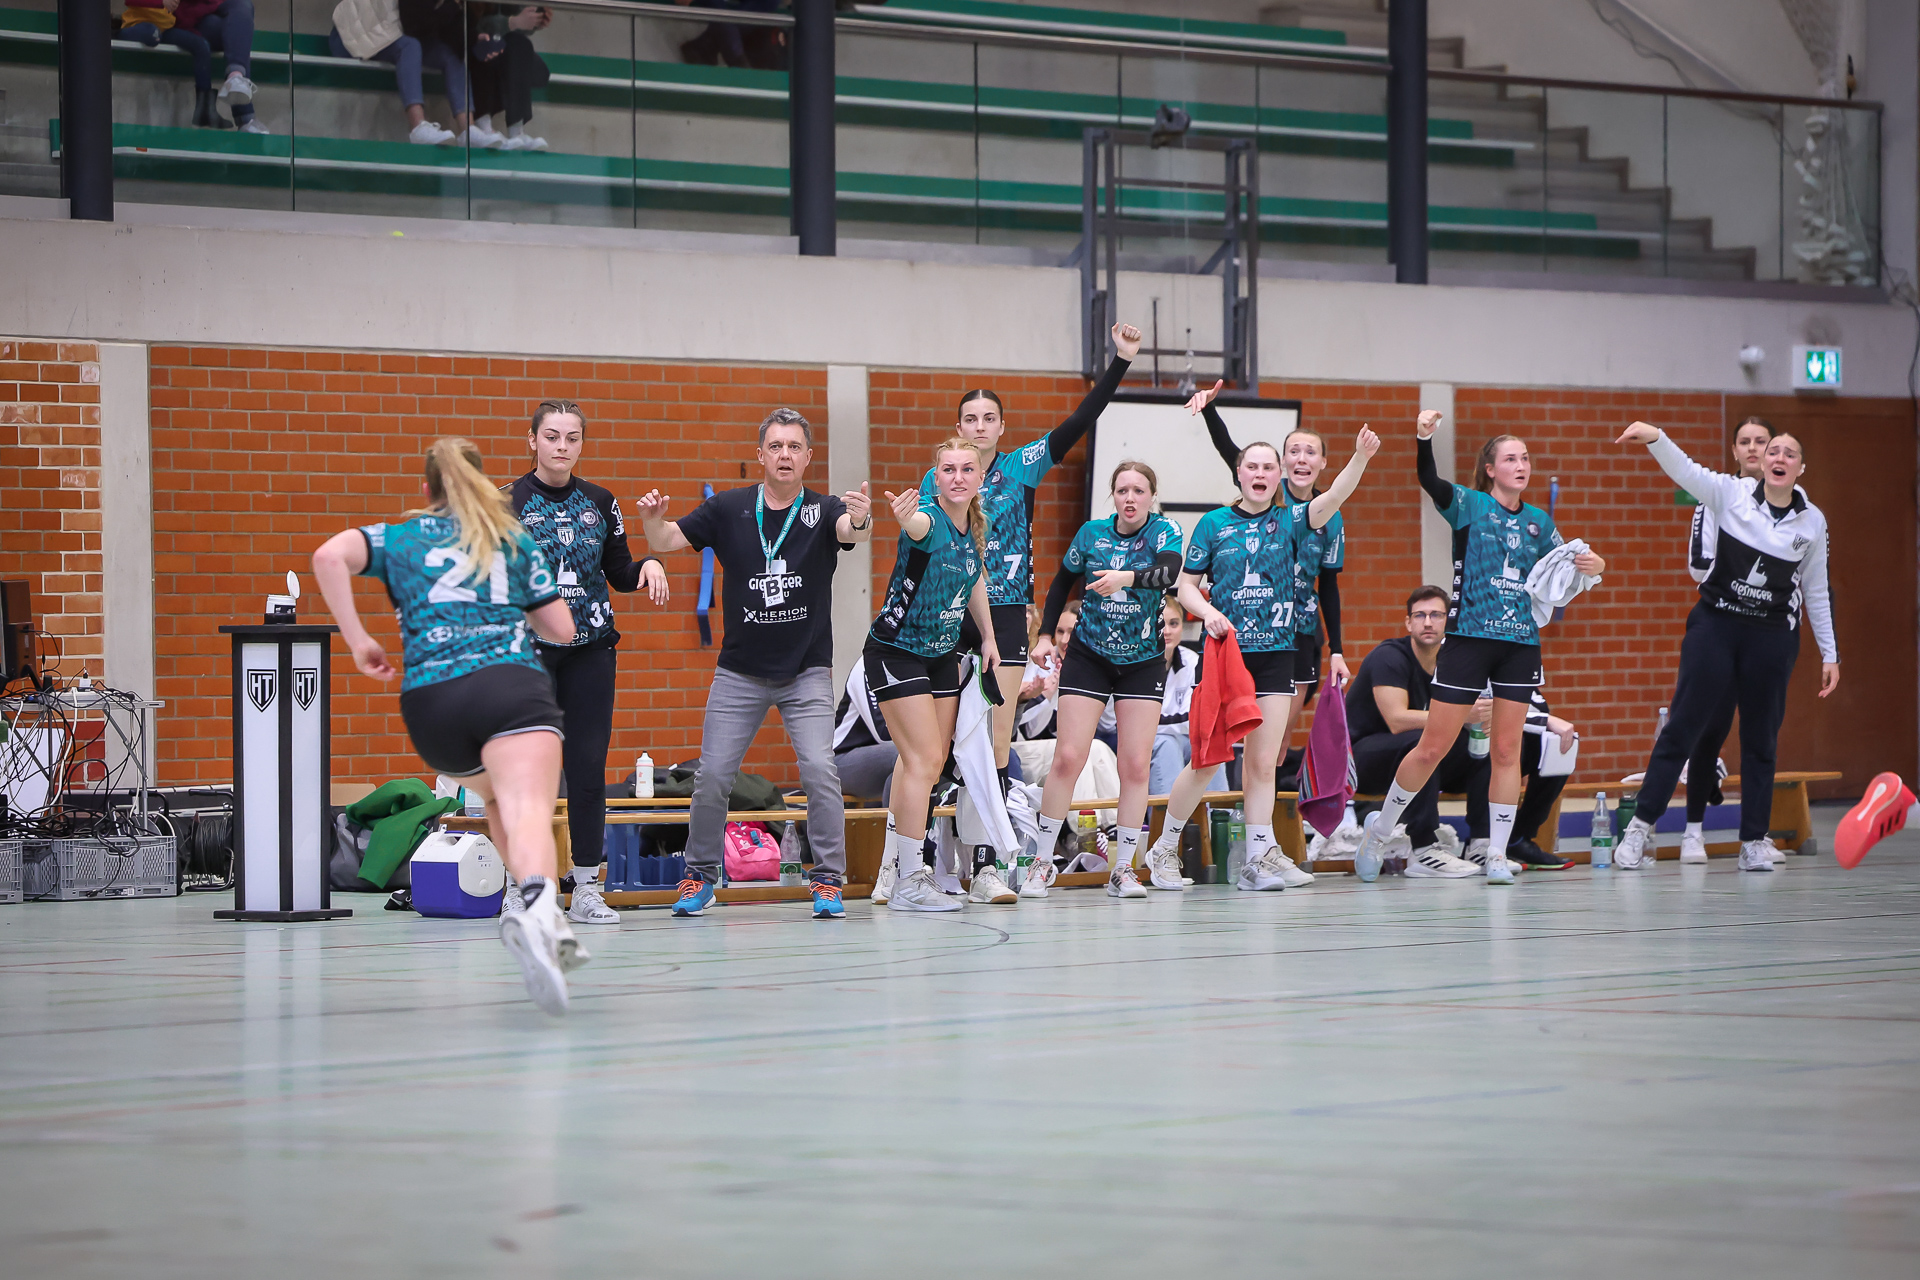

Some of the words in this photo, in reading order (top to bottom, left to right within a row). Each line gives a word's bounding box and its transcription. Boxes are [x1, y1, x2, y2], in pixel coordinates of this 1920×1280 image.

[424, 547, 510, 605] 21
[1003, 553, 1023, 580] 7
[765, 579, 781, 598] B
[759, 605, 807, 618] HERION
[1271, 601, 1294, 628] 27
[1484, 619, 1531, 631] HERION
[1235, 632, 1275, 640] ERION
